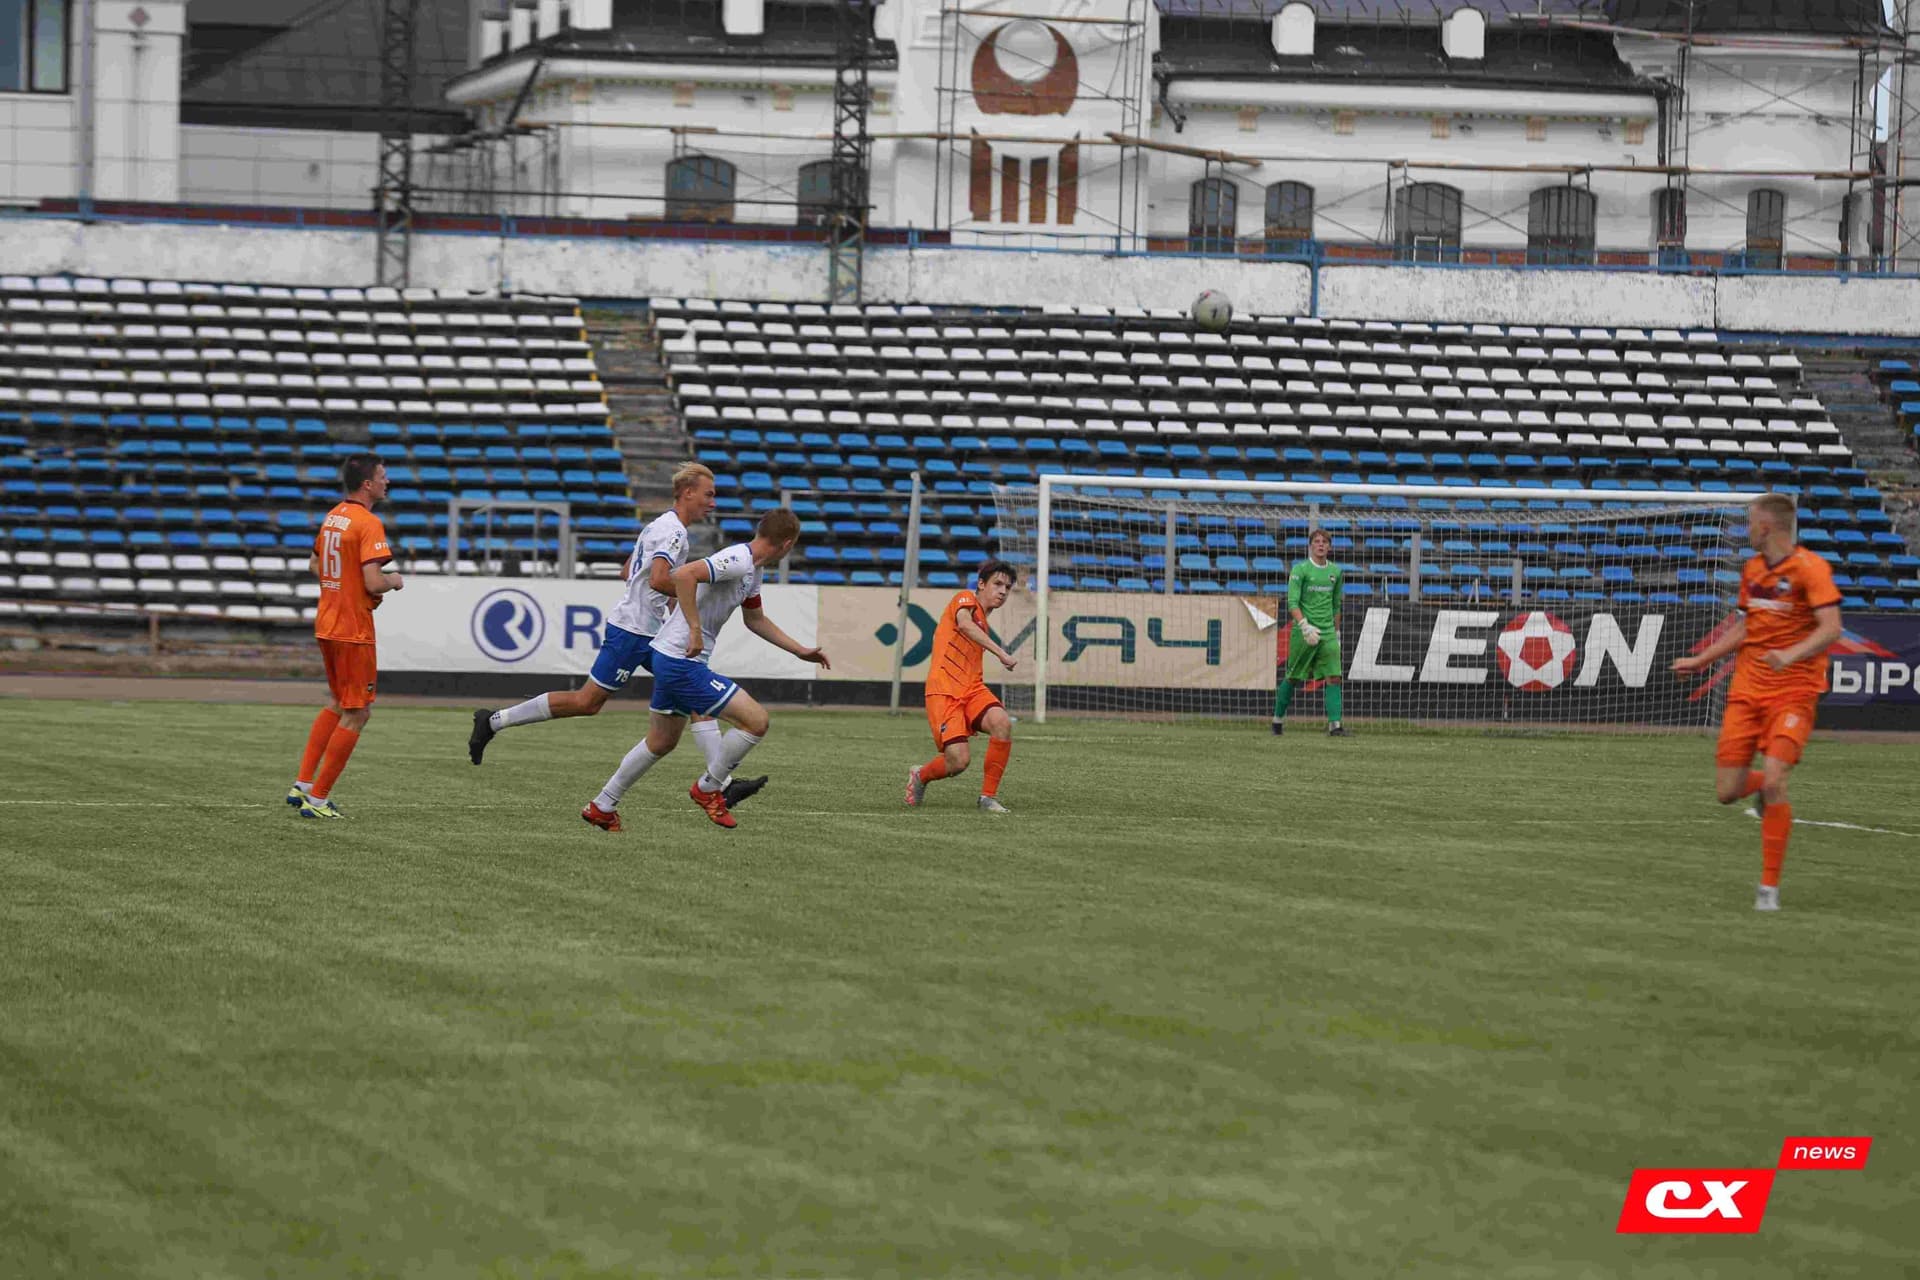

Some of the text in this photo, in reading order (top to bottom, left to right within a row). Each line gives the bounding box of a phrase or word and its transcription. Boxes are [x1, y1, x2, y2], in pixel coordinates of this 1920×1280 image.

[323, 530, 342, 579] 15
[1348, 607, 1665, 692] LEON
[616, 668, 631, 683] 78
[709, 679, 727, 693] 4
